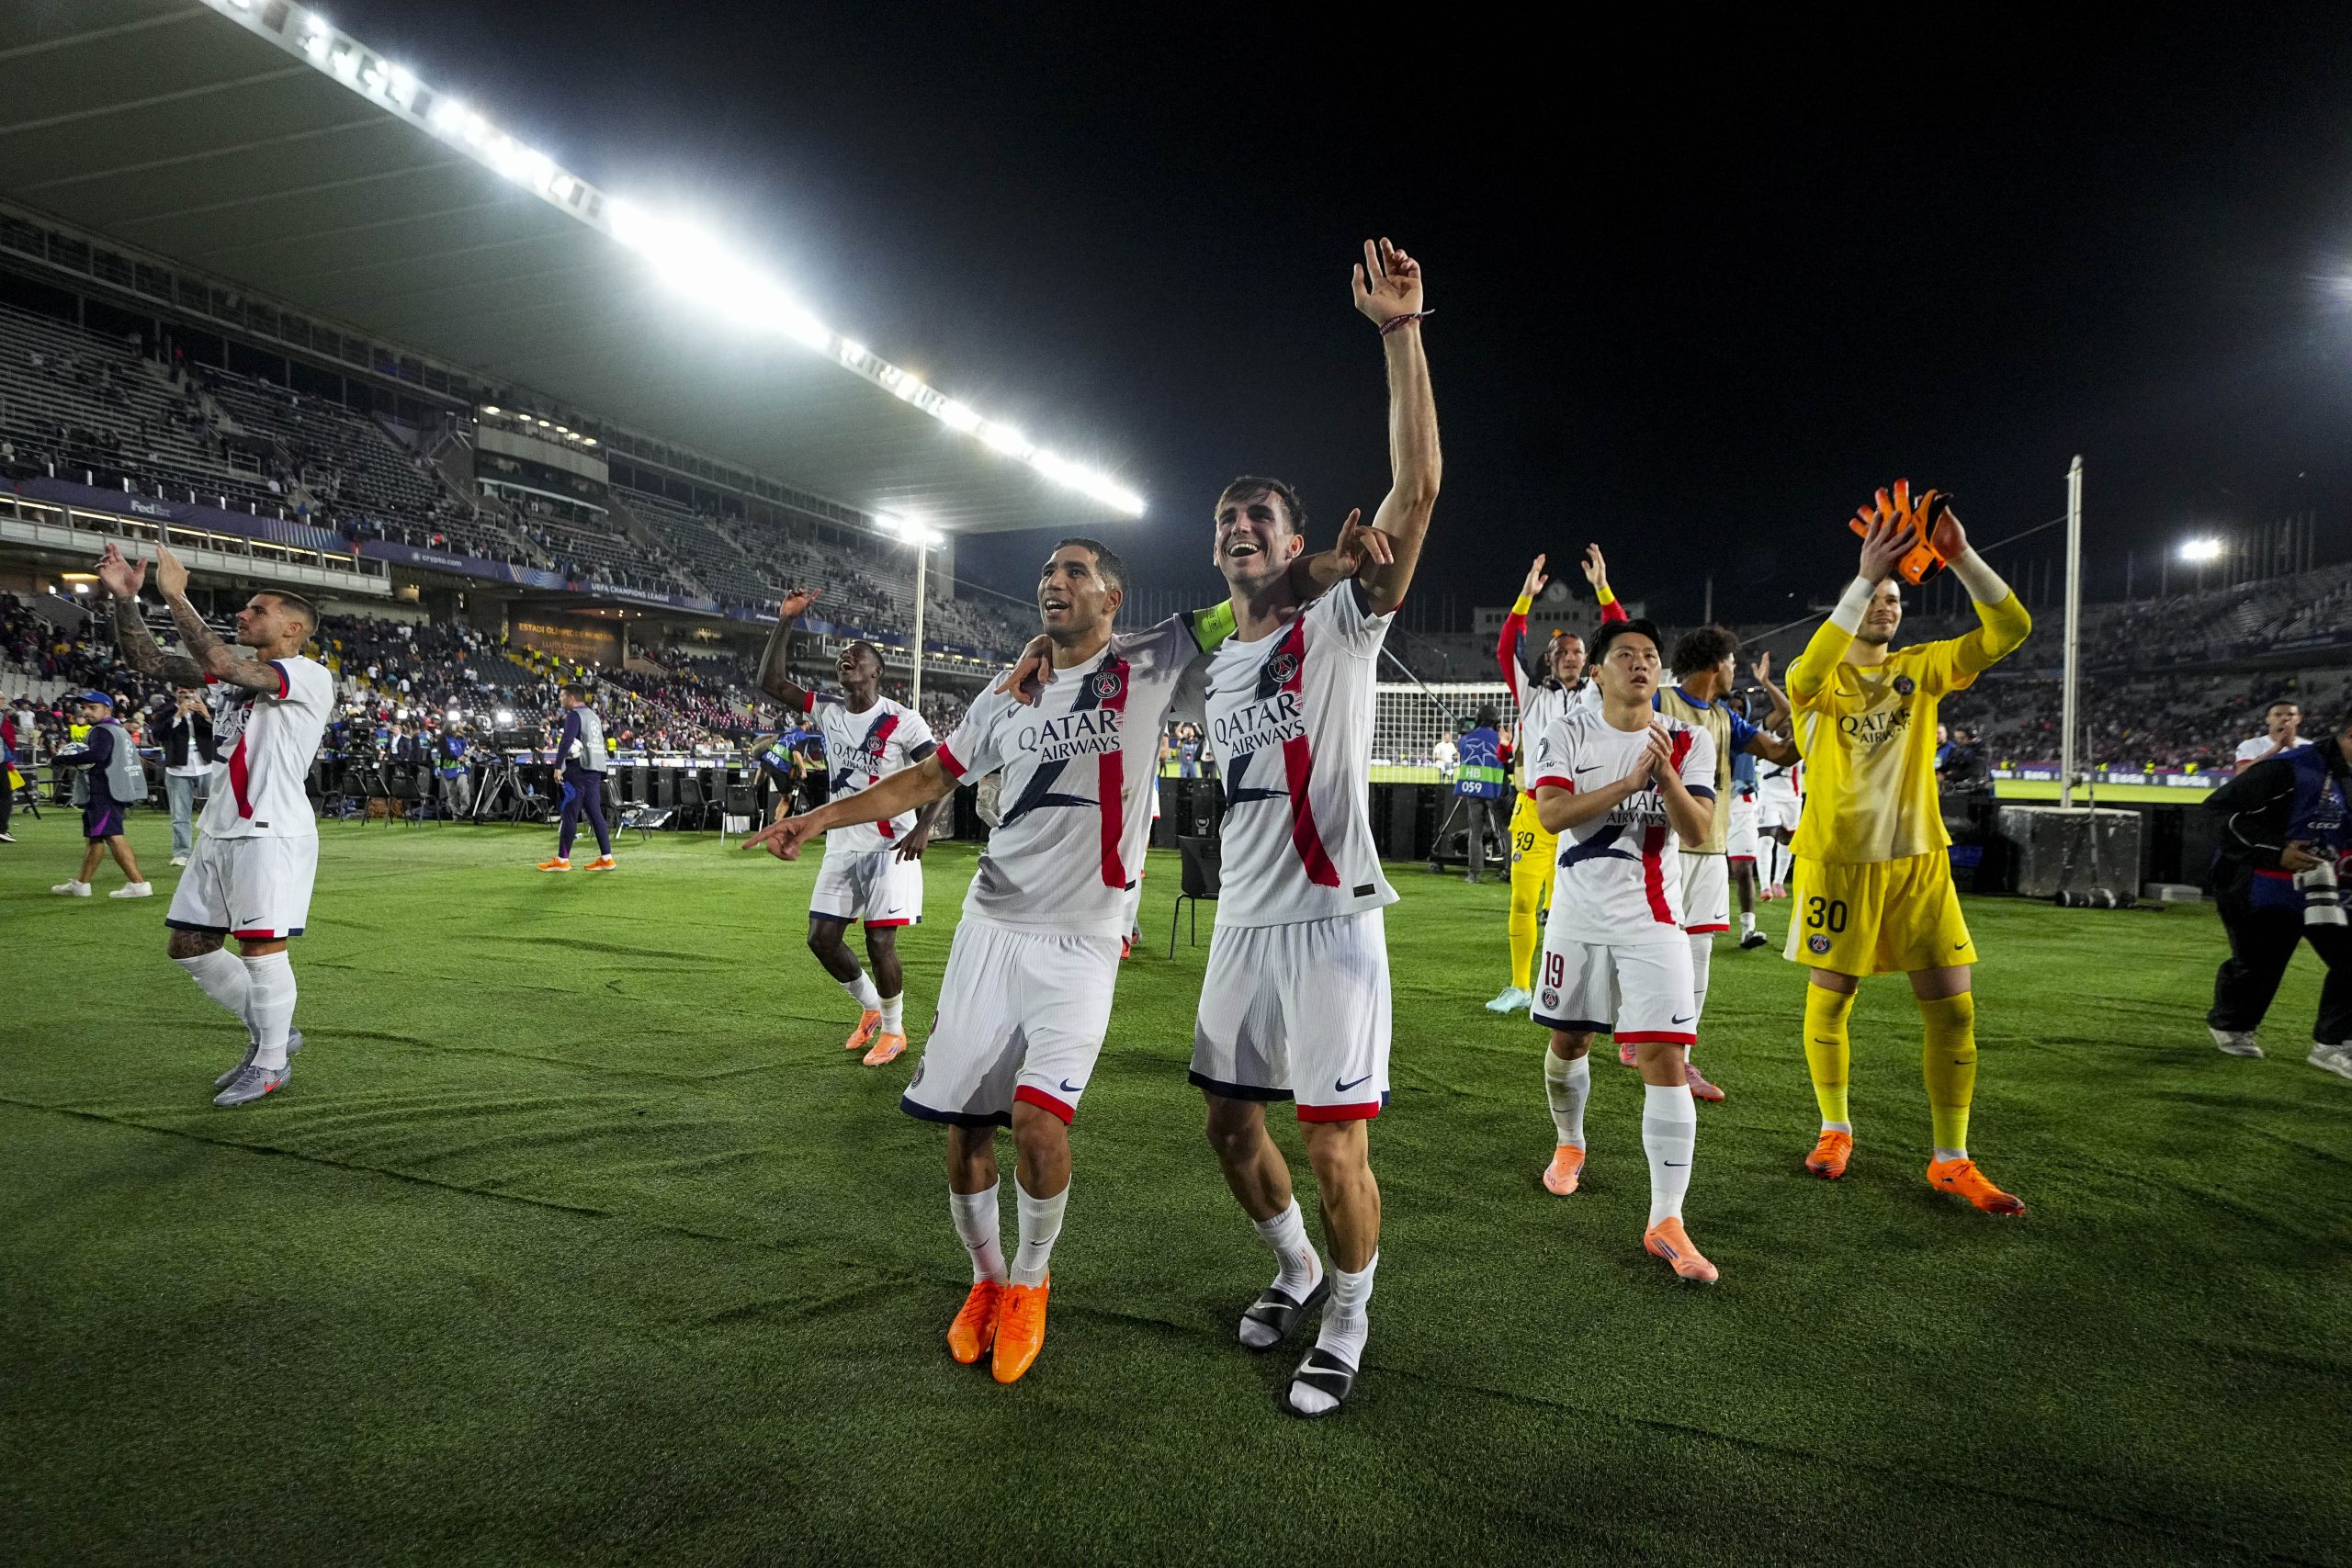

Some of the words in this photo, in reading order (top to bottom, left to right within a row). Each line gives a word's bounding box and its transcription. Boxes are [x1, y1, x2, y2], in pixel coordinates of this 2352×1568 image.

[130, 500, 171, 518] FedEx
[422, 554, 462, 567] crypto.com
[591, 582, 609, 593] UEFA
[610, 585, 647, 599] CHAMPIONS
[647, 592, 670, 603] LEAGUE
[518, 623, 545, 634] ESTADI
[1215, 693, 1301, 747] QATAR
[1018, 709, 1119, 752] QATAR
[1231, 719, 1306, 757] AIRWAYS
[766, 750, 780, 764] 018
[833, 742, 879, 767] QATAR
[1040, 736, 1121, 762] AIRWAYS
[842, 759, 879, 774] AIRWAYS
[1465, 767, 1481, 778] HB
[1461, 781, 1482, 793] 059
[1605, 811, 1667, 826] AIRWAYS
[1806, 896, 1848, 933] 30
[1544, 950, 1565, 989] 19
